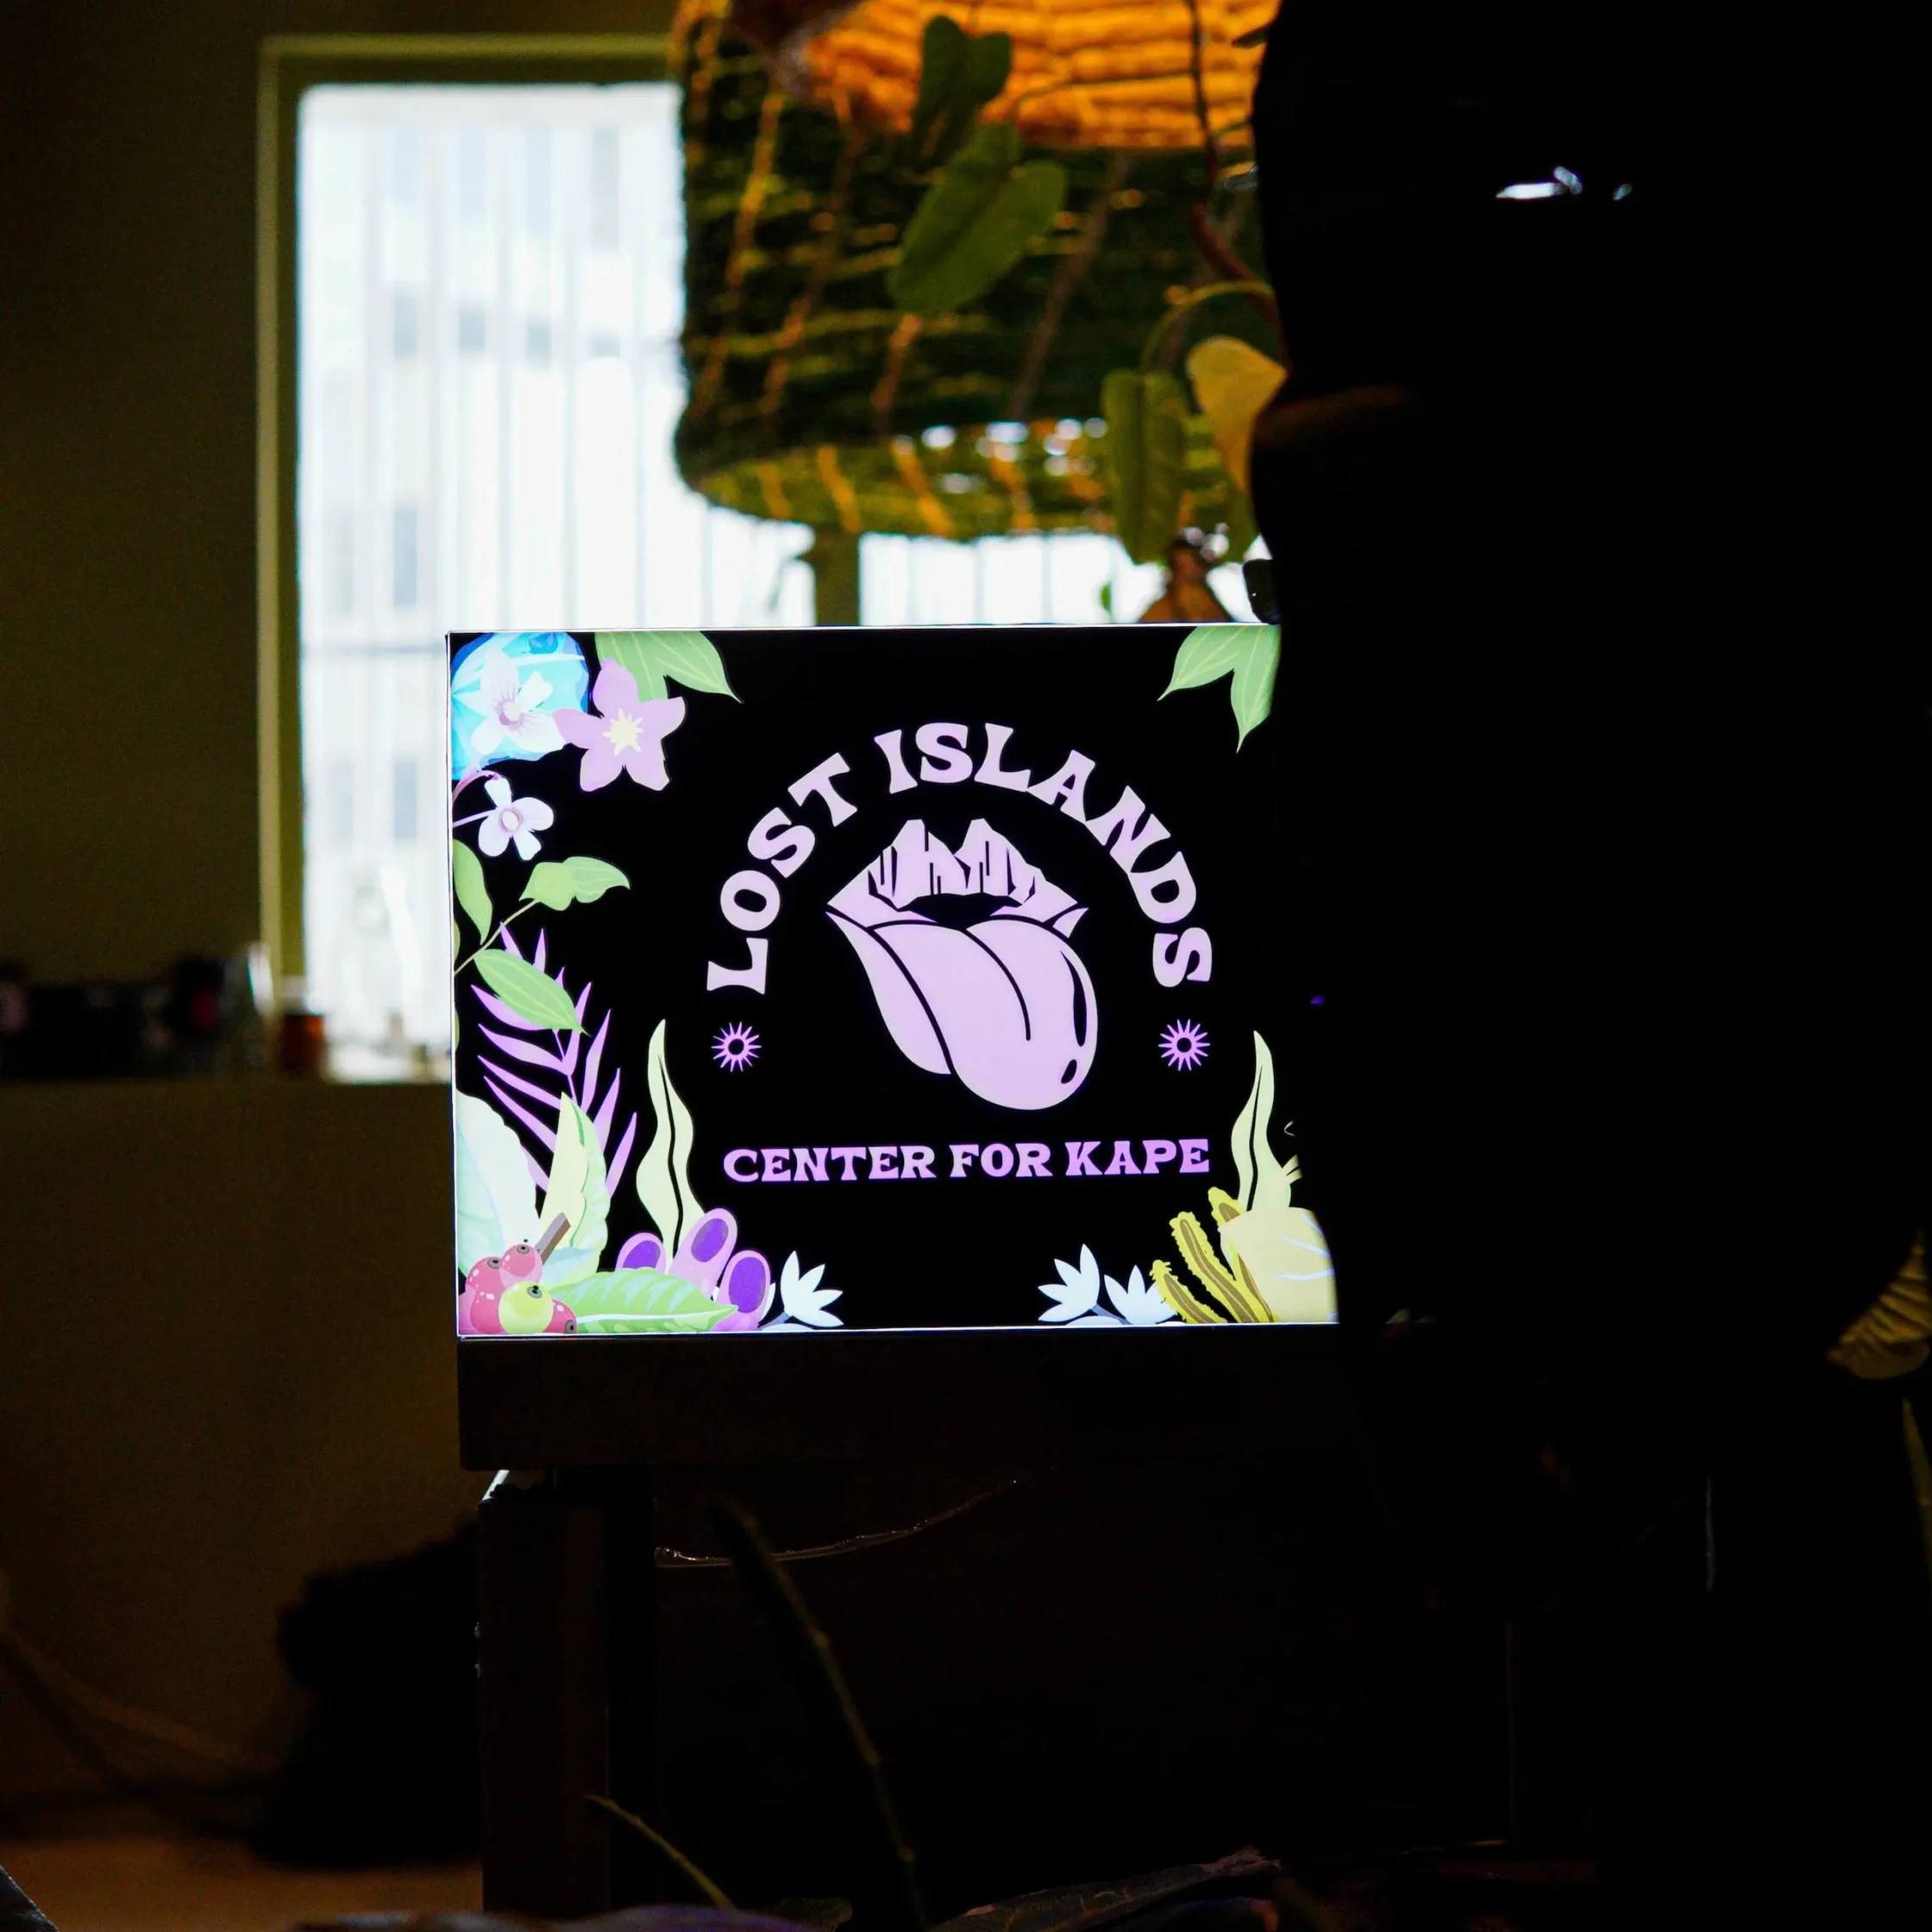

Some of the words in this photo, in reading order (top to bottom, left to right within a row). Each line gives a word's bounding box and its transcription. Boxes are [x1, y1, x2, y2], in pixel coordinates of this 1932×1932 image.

[706, 752, 858, 995] LOST
[874, 722, 1213, 988] ISLANDS
[723, 1145, 937, 1182] CENTER
[949, 1142, 1053, 1178] FOR
[1064, 1138, 1210, 1176] KAPE
